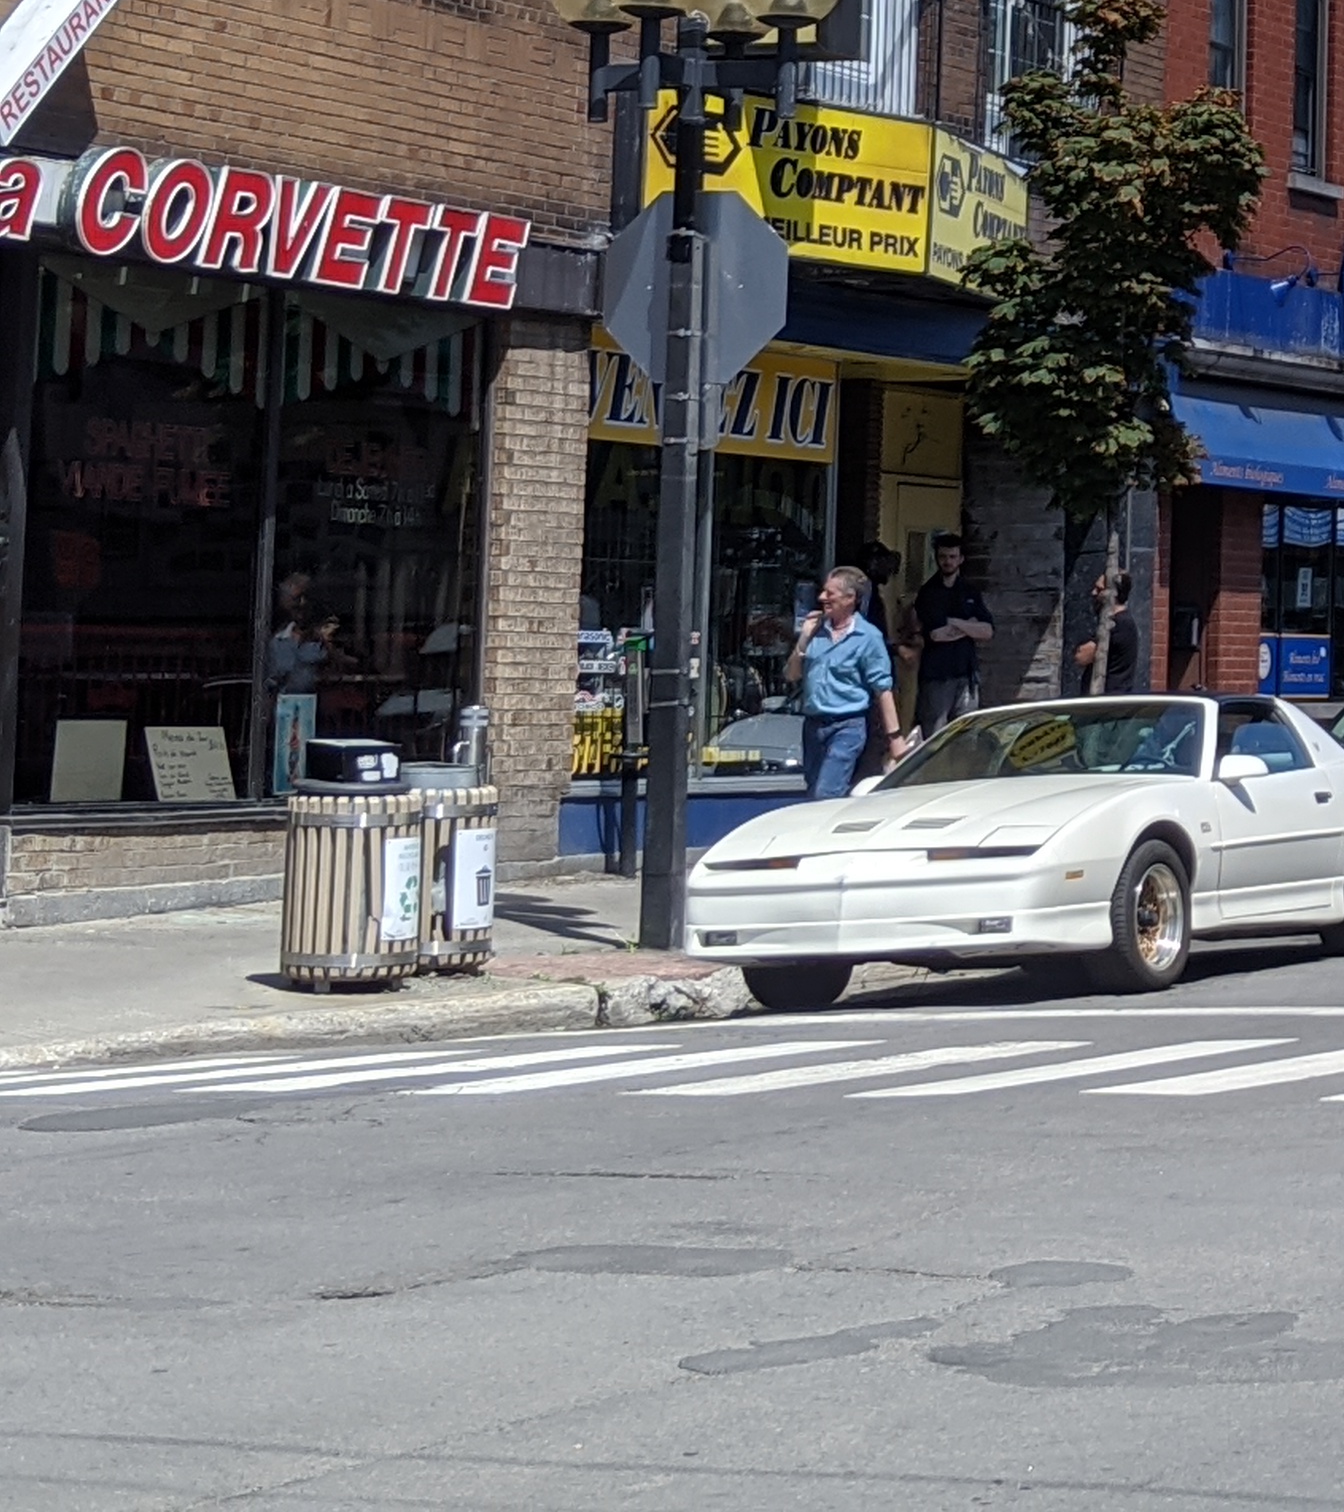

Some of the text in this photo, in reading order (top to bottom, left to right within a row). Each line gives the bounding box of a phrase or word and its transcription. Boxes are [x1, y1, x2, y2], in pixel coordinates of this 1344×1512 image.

[770, 158, 926, 215] COMPTANT
[76, 145, 533, 310] CORVETTE
[766, 216, 919, 259] EILLEUR PRIX
[767, 373, 835, 449] ICI
